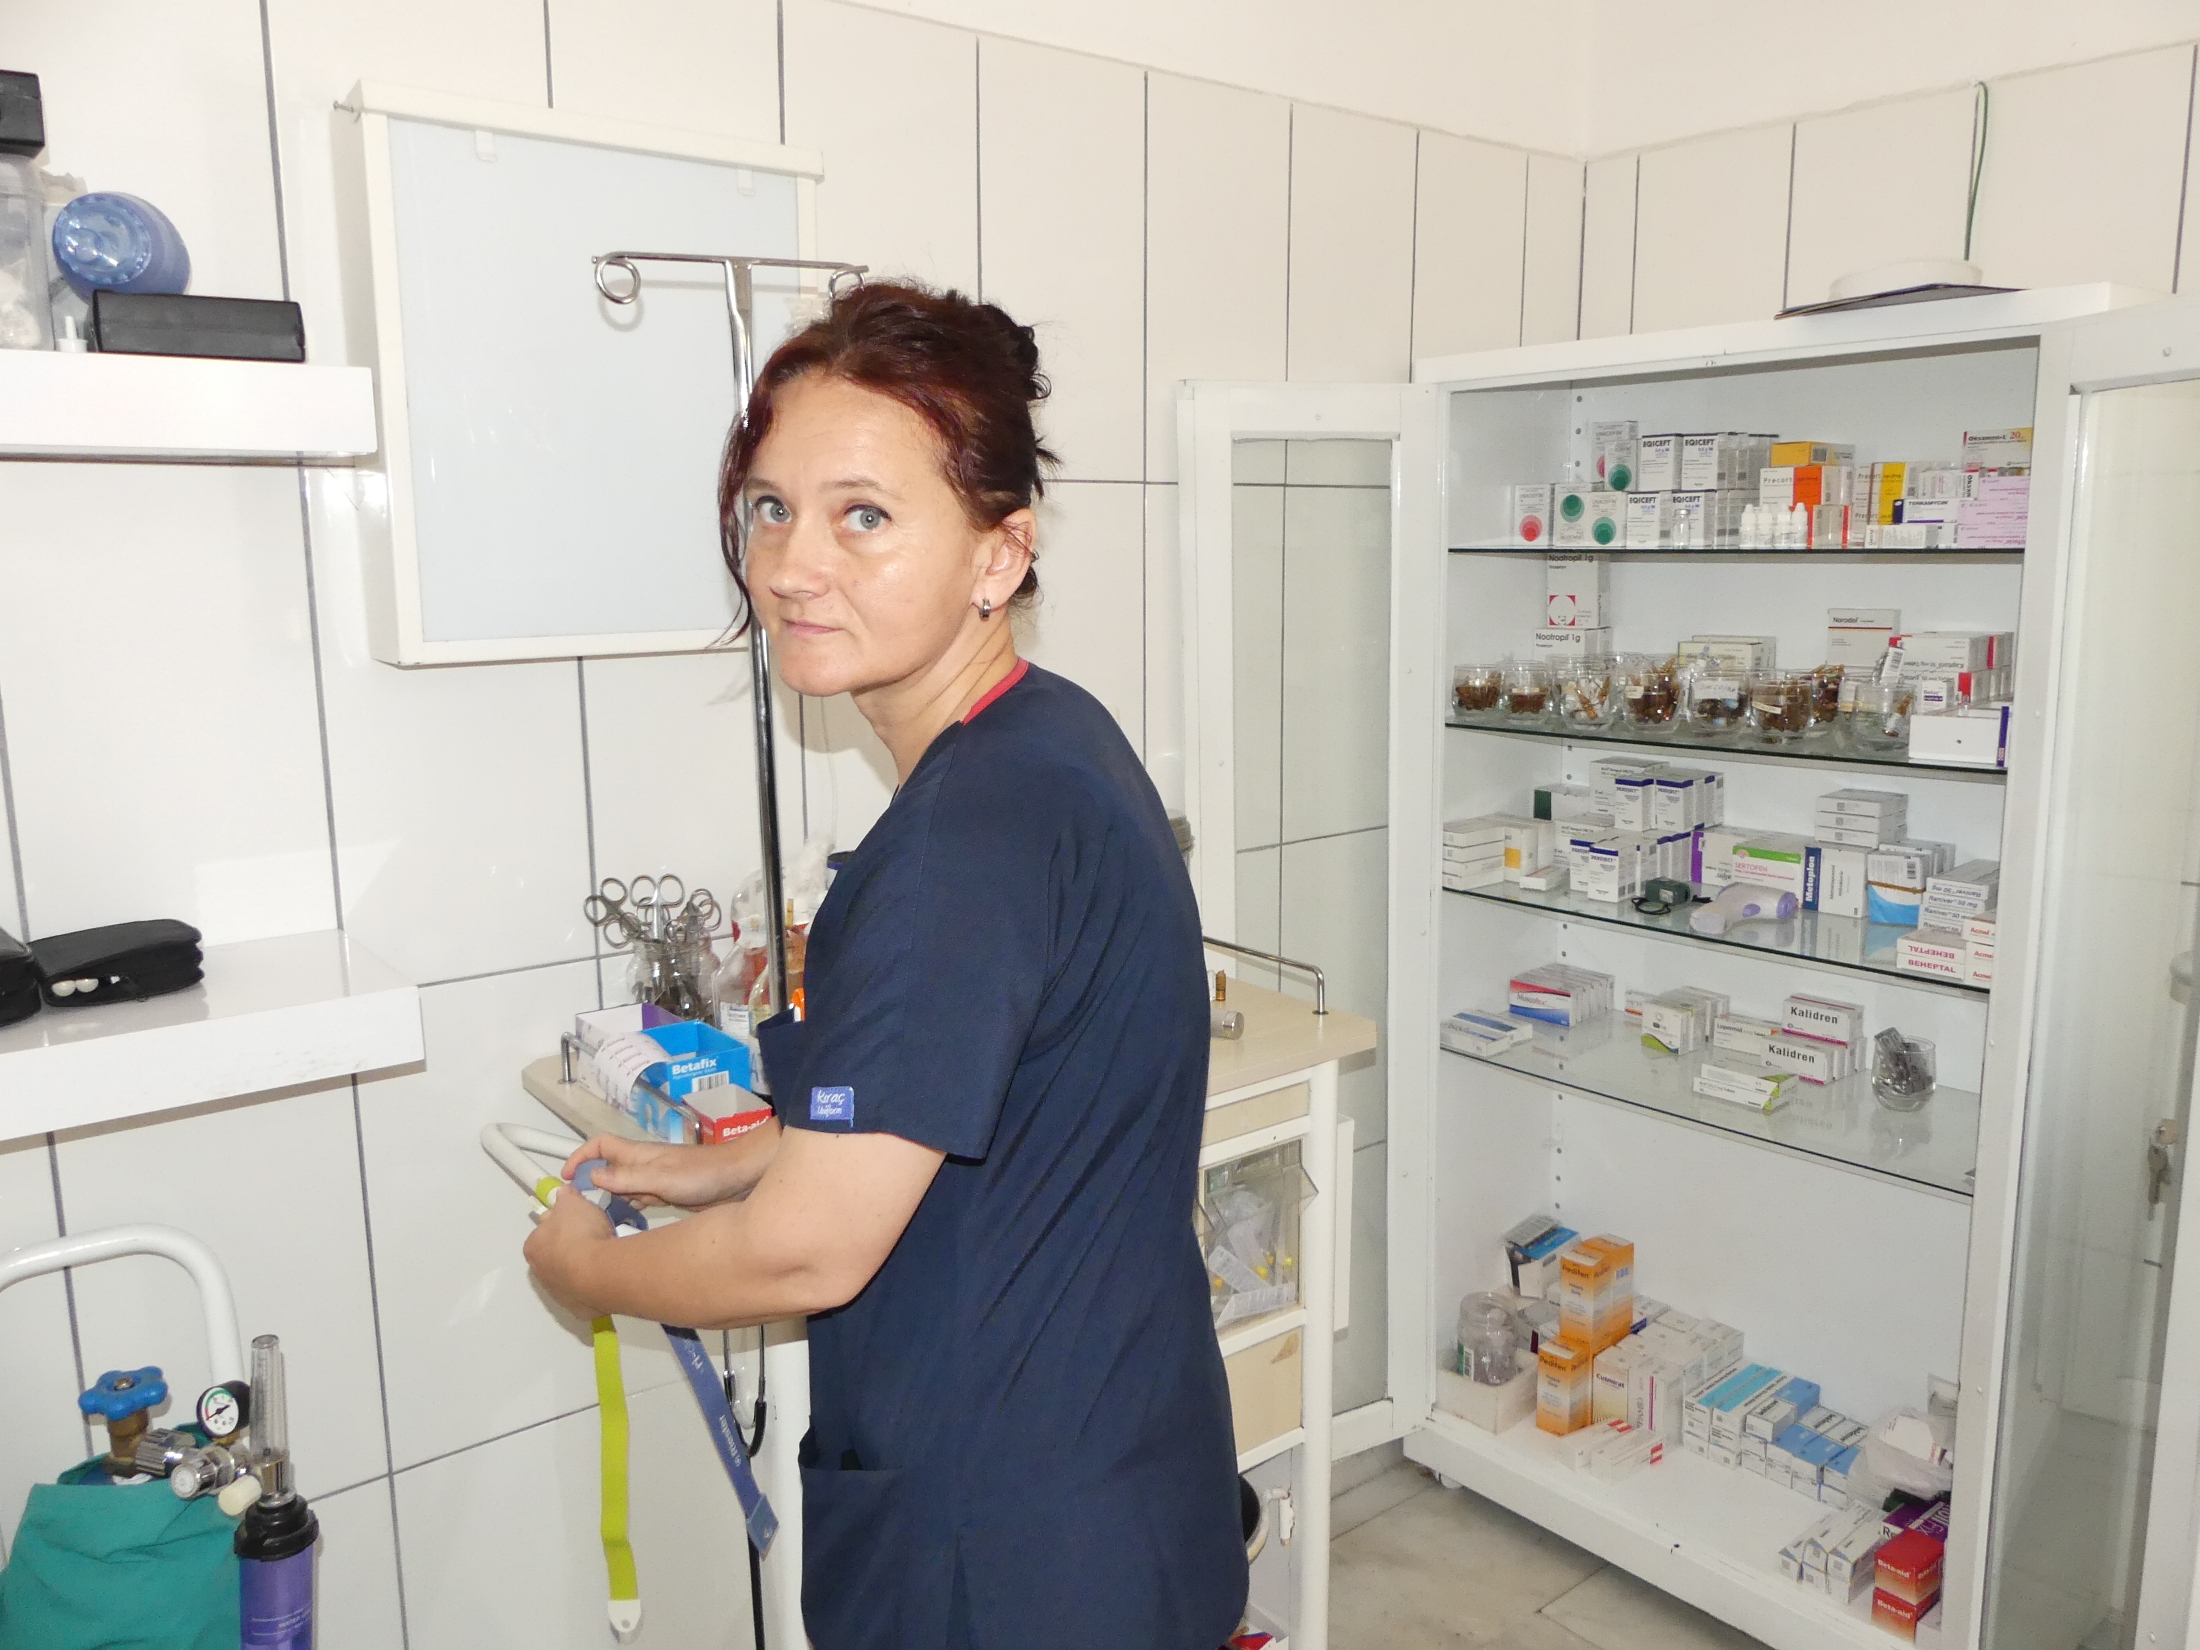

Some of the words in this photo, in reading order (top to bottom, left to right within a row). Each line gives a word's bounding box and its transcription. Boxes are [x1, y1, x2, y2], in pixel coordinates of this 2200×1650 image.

[1535, 633, 1569, 642] Nootropil
[1572, 634, 1581, 643] 1g
[1735, 862, 1768, 872] SERTOFEN
[1805, 856, 1815, 902] Metoplon
[1924, 907, 1948, 916] Raniver
[1908, 945, 1955, 959] BEHEPTAL
[1908, 959, 1956, 973] BEHEPTAL
[1791, 1006, 1839, 1024] Kalidren
[1768, 1044, 1815, 1064] Kalidren
[671, 1057, 717, 1076] Betafix
[817, 1104, 843, 1118] Uniform
[723, 1116, 768, 1137] Beta-ai
[1878, 1559, 1910, 1578] Beta-aid
[1877, 1599, 1911, 1619] Beta-aid
